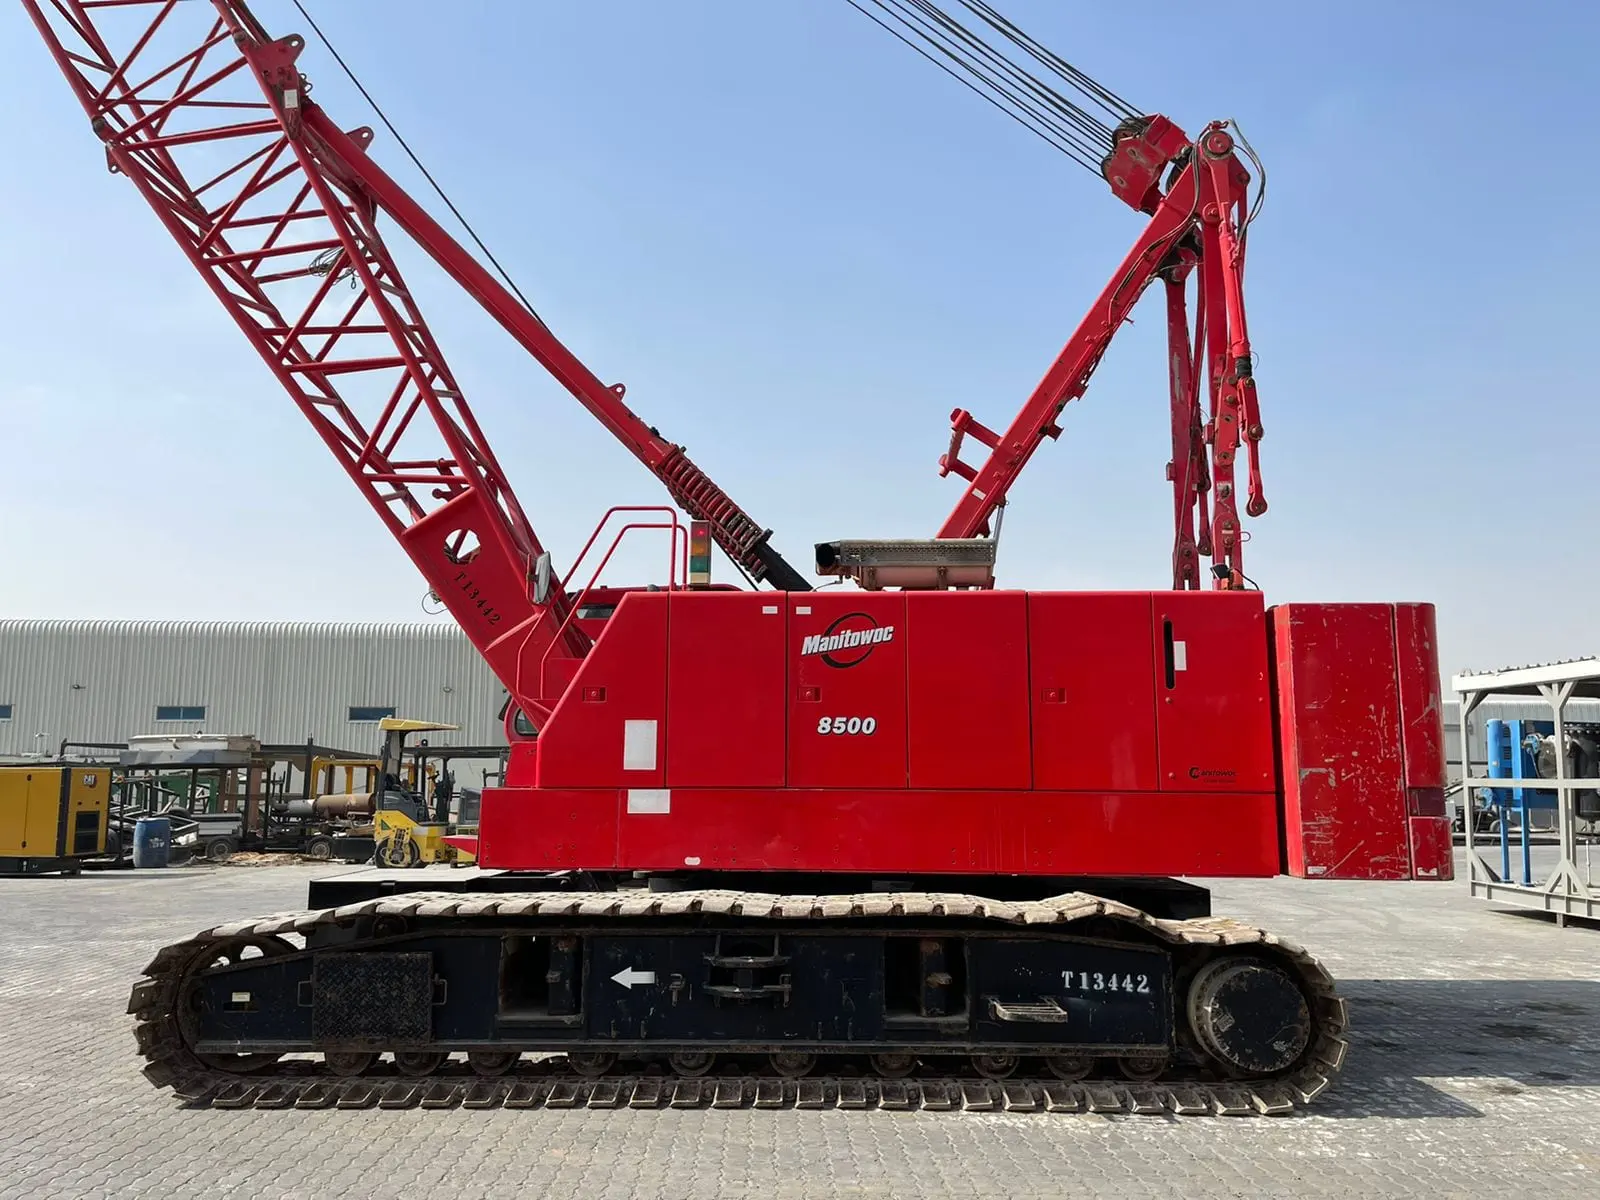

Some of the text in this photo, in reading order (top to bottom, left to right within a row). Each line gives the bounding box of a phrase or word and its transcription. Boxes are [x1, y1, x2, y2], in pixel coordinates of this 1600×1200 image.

[801, 626, 894, 655] Manitowoc
[817, 716, 876, 735] 8500
[1061, 970, 1150, 993] T13442
